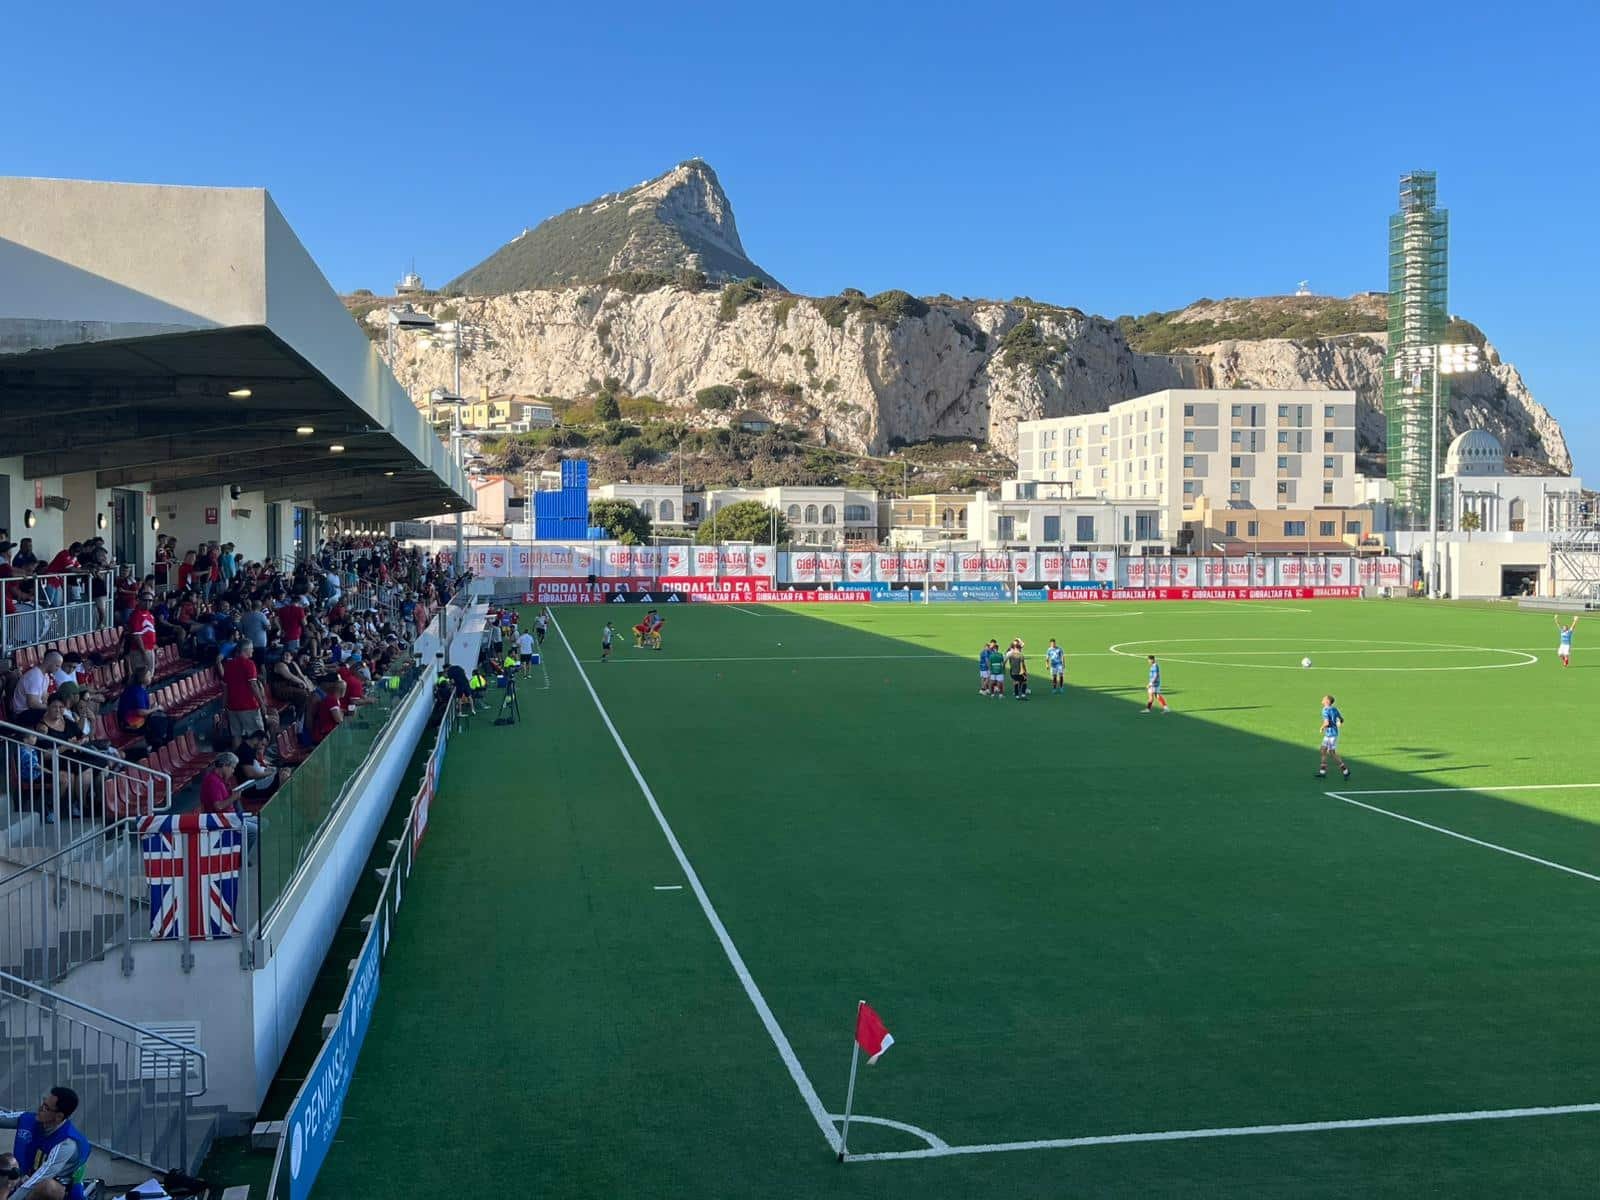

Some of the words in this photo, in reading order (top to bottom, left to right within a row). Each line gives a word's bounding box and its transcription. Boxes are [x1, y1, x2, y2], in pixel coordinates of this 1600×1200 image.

[538, 593, 577, 602] GIBRALTAR
[580, 593, 590, 602] FA
[756, 592, 793, 601] GIBRALTAR
[795, 592, 803, 601] FA
[818, 592, 854, 601] GIBRALTAR
[856, 592, 865, 601] FA
[1052, 591, 1088, 600] GIBRALTAR
[1090, 591, 1100, 600] FA
[1112, 591, 1146, 600] GIBRALTAR
[1148, 591, 1157, 600] FA
[1191, 590, 1226, 599] GIBRALTAR
[1228, 590, 1236, 599] FA
